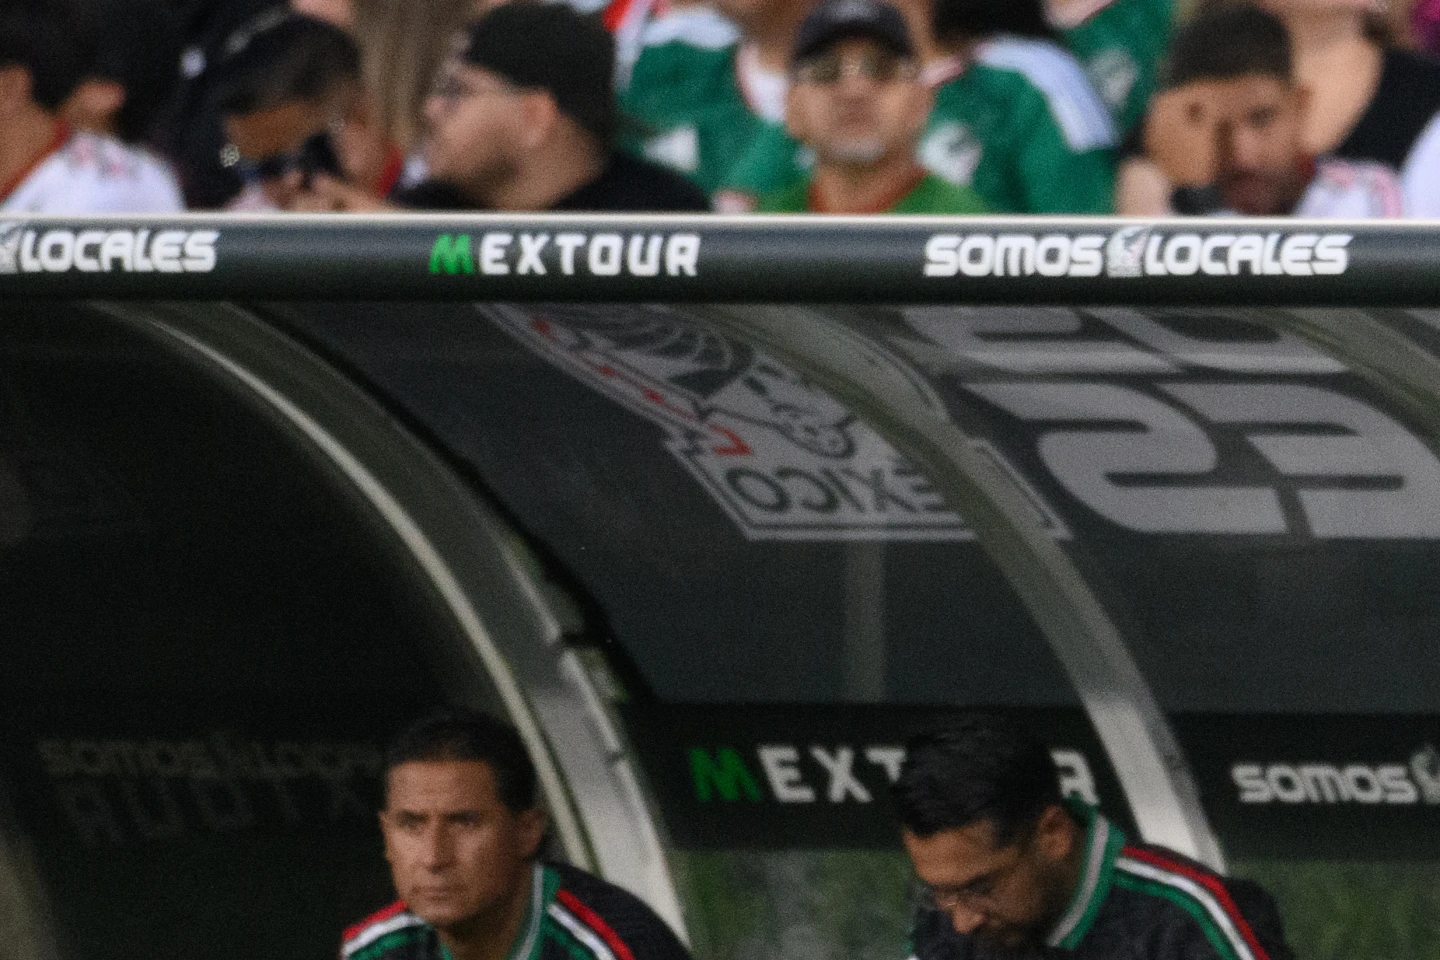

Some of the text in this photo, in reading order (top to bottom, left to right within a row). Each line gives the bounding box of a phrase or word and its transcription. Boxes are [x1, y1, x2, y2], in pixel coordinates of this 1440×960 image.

[21, 230, 219, 272] LOCALES
[428, 233, 701, 277] MEXTOUR
[923, 233, 1353, 277] SOMOS LOCALES
[690, 745, 1099, 804] MEXTR
[1232, 764, 1418, 804] SOMOS
